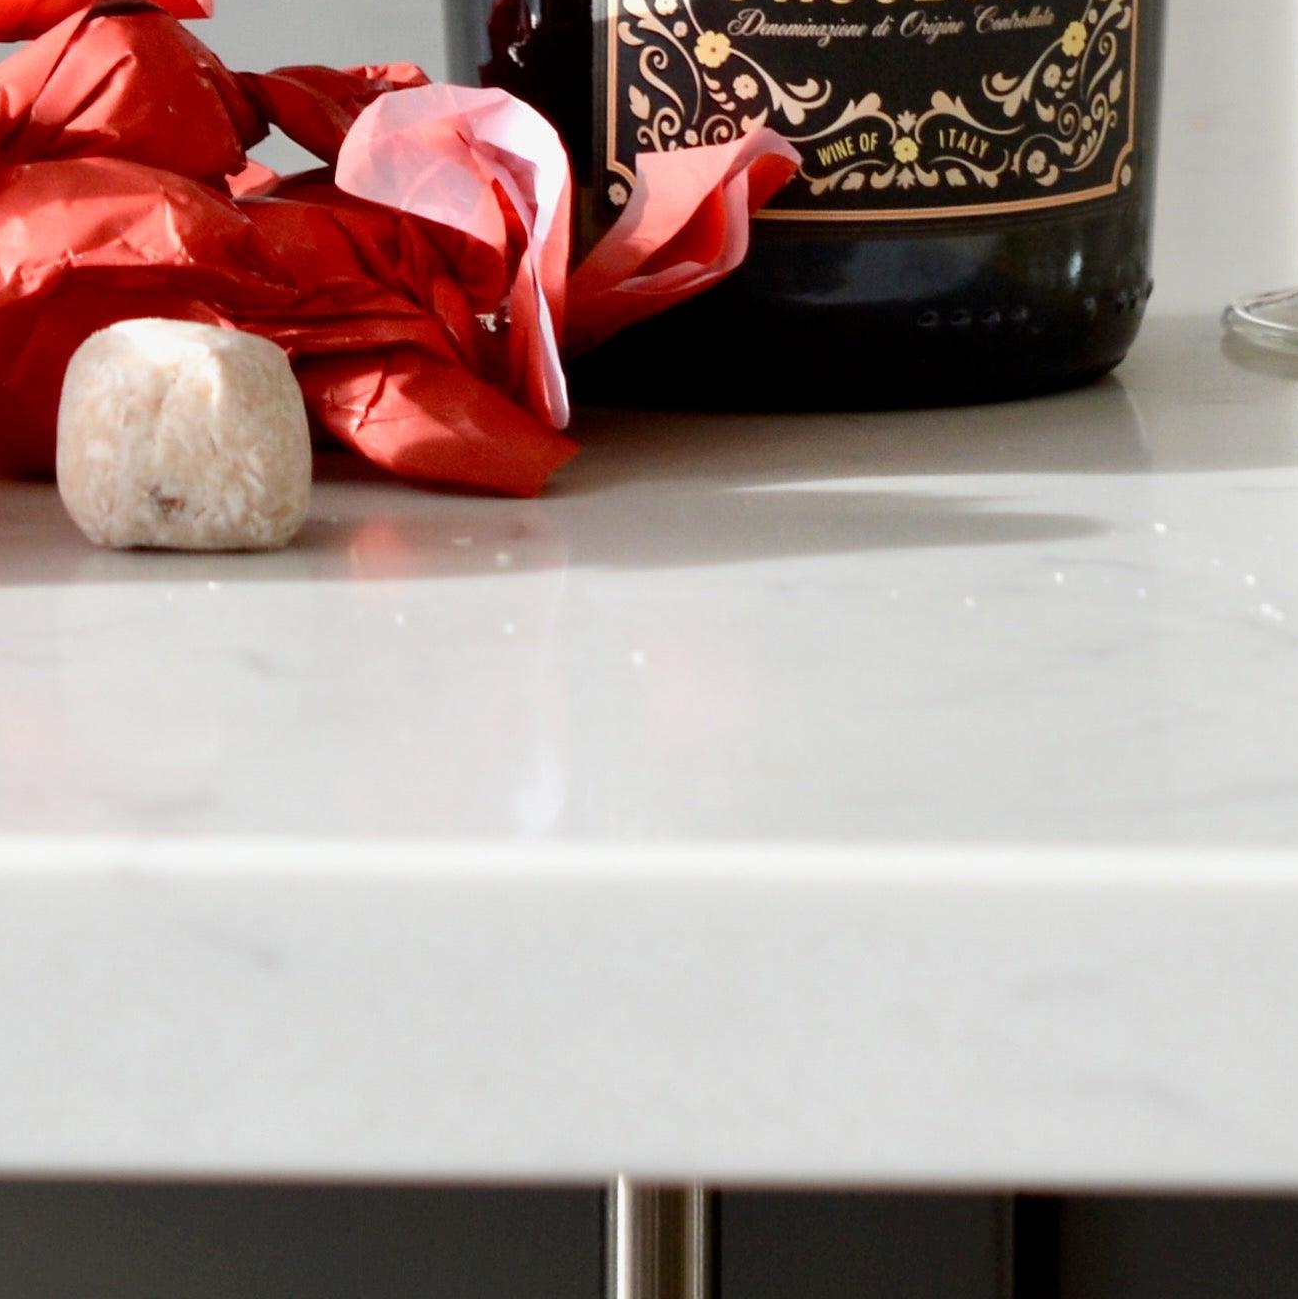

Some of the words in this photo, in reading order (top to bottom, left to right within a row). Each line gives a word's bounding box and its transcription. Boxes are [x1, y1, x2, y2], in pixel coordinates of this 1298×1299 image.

[727, 8, 868, 48] Denominazione
[871, 14, 895, 38] di
[899, 9, 966, 45] Origine
[816, 135, 856, 167] WINE
[859, 131, 879, 153] OF
[938, 128, 991, 159] ITALY
